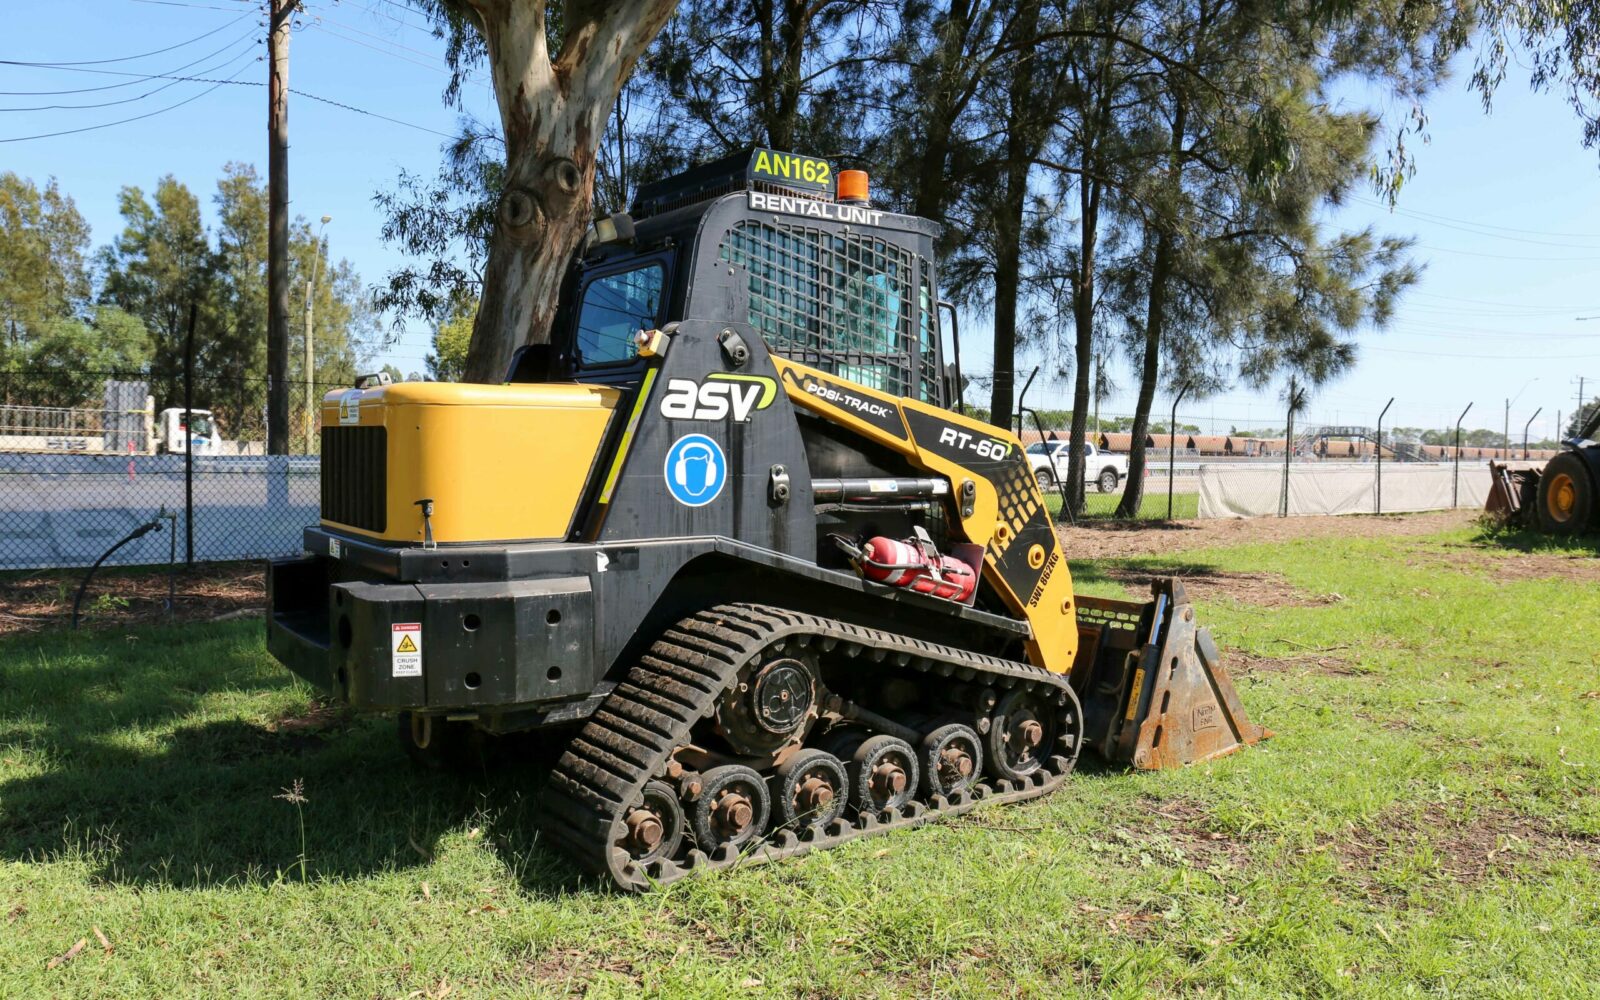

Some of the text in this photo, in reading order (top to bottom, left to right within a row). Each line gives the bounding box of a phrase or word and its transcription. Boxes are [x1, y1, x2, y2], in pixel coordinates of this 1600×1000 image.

[754, 151, 829, 184] AN162
[751, 193, 883, 226] RENTAL UNIT
[807, 383, 888, 418] POSI-TRACK
[939, 427, 1006, 461] RT-60
[1030, 552, 1059, 608] SWL 862KG
